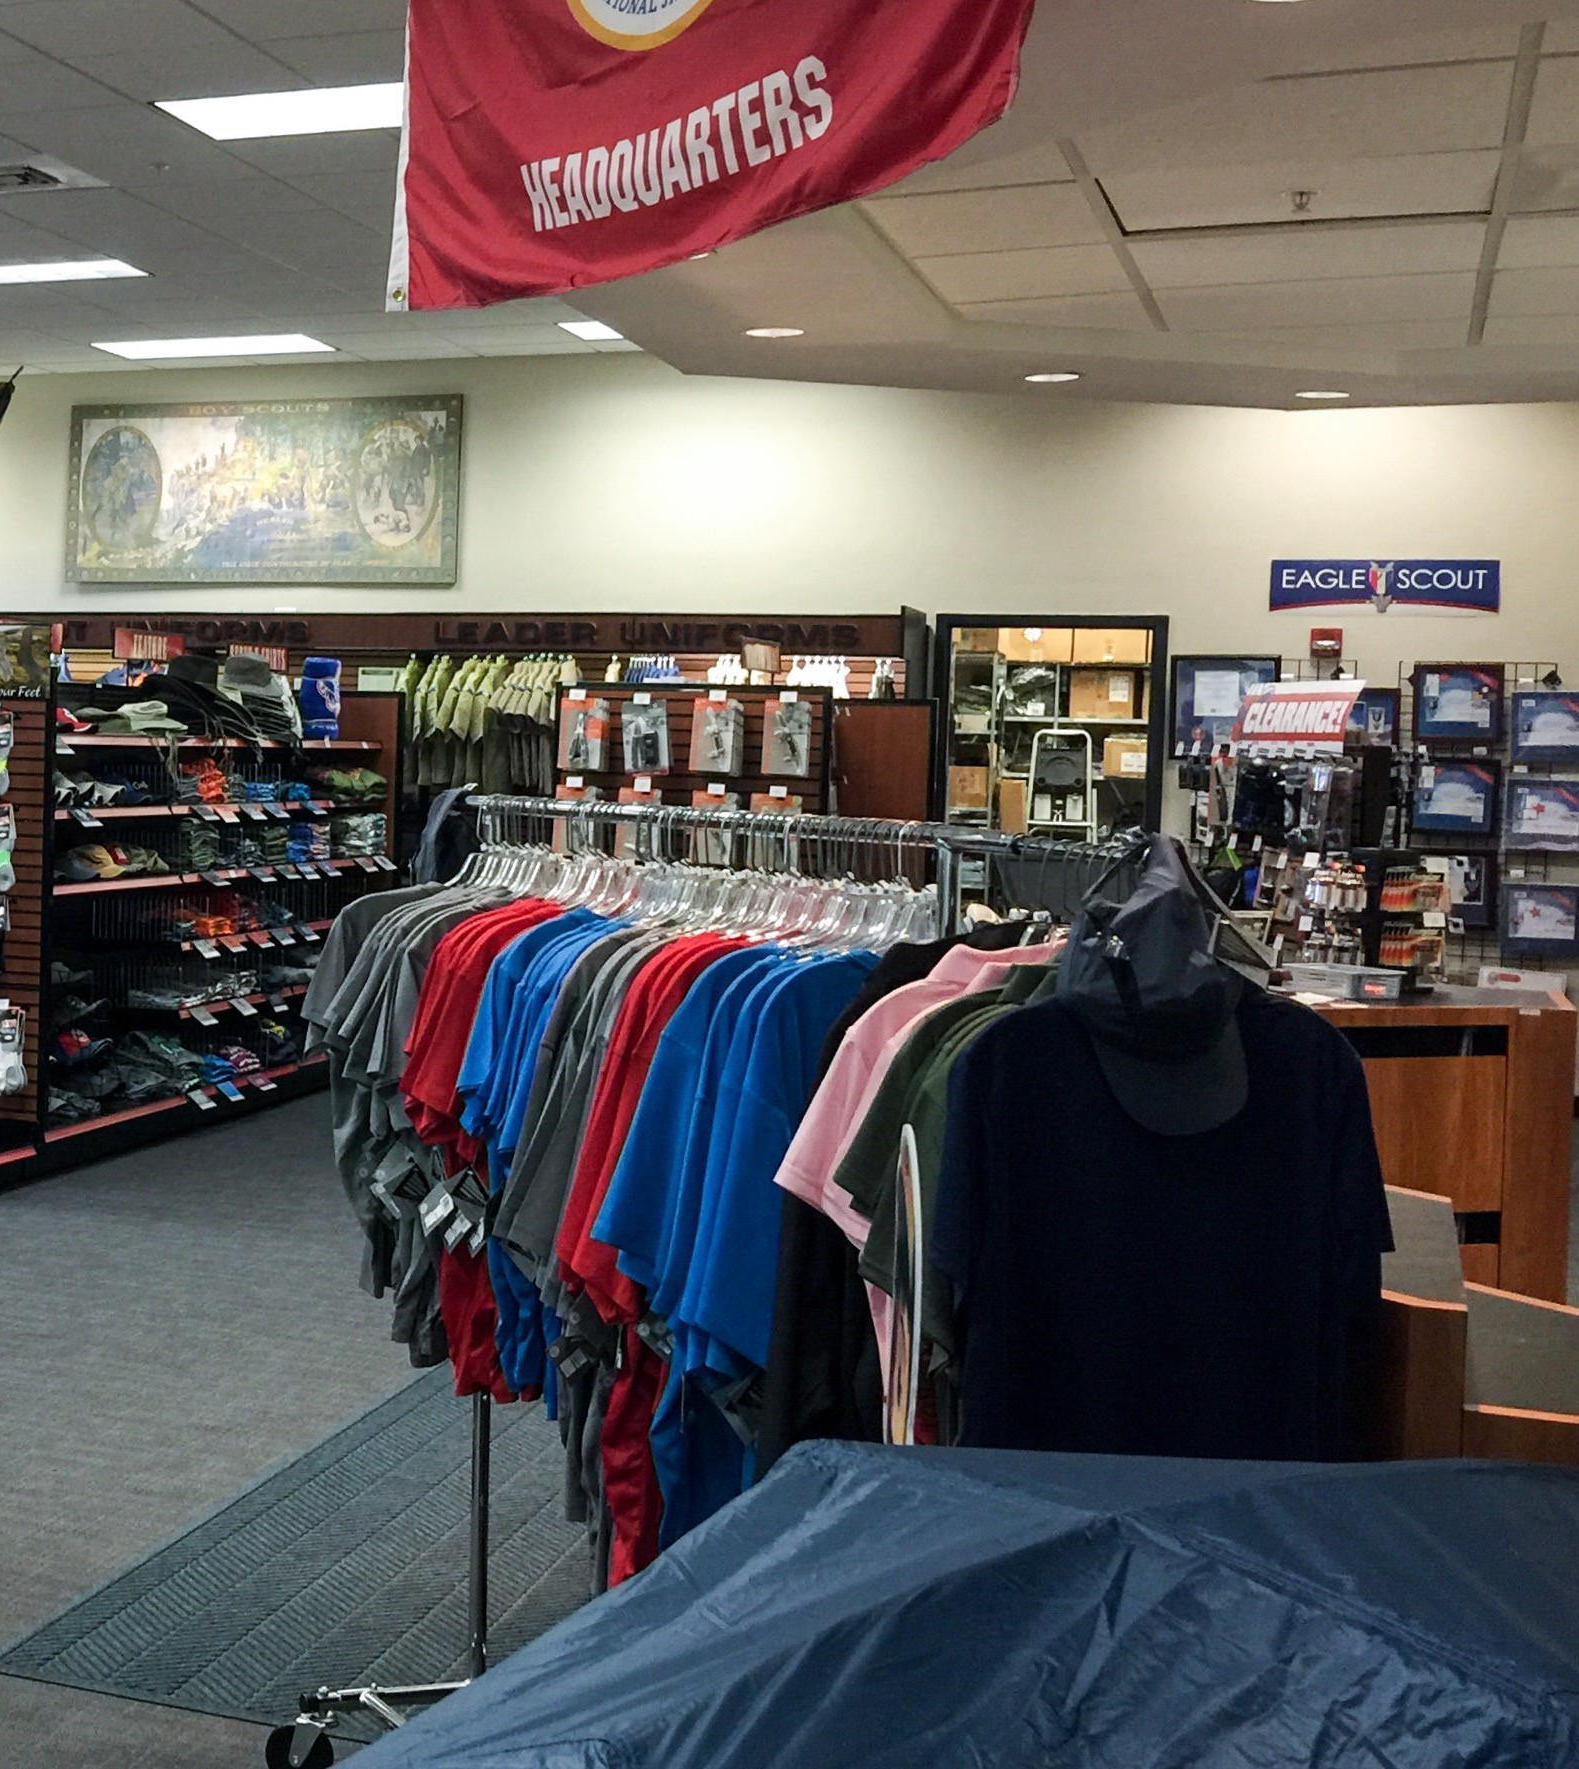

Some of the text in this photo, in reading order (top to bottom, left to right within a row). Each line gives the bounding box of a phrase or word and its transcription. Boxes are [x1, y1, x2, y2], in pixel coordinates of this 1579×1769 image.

[520, 54, 833, 232] HEADQUARTERS
[1281, 568, 1489, 590] EAGLE SCOUT
[434, 621, 598, 646] LEADER
[17, 685, 41, 698] Feet
[1242, 700, 1350, 733] CLEARANCE!
